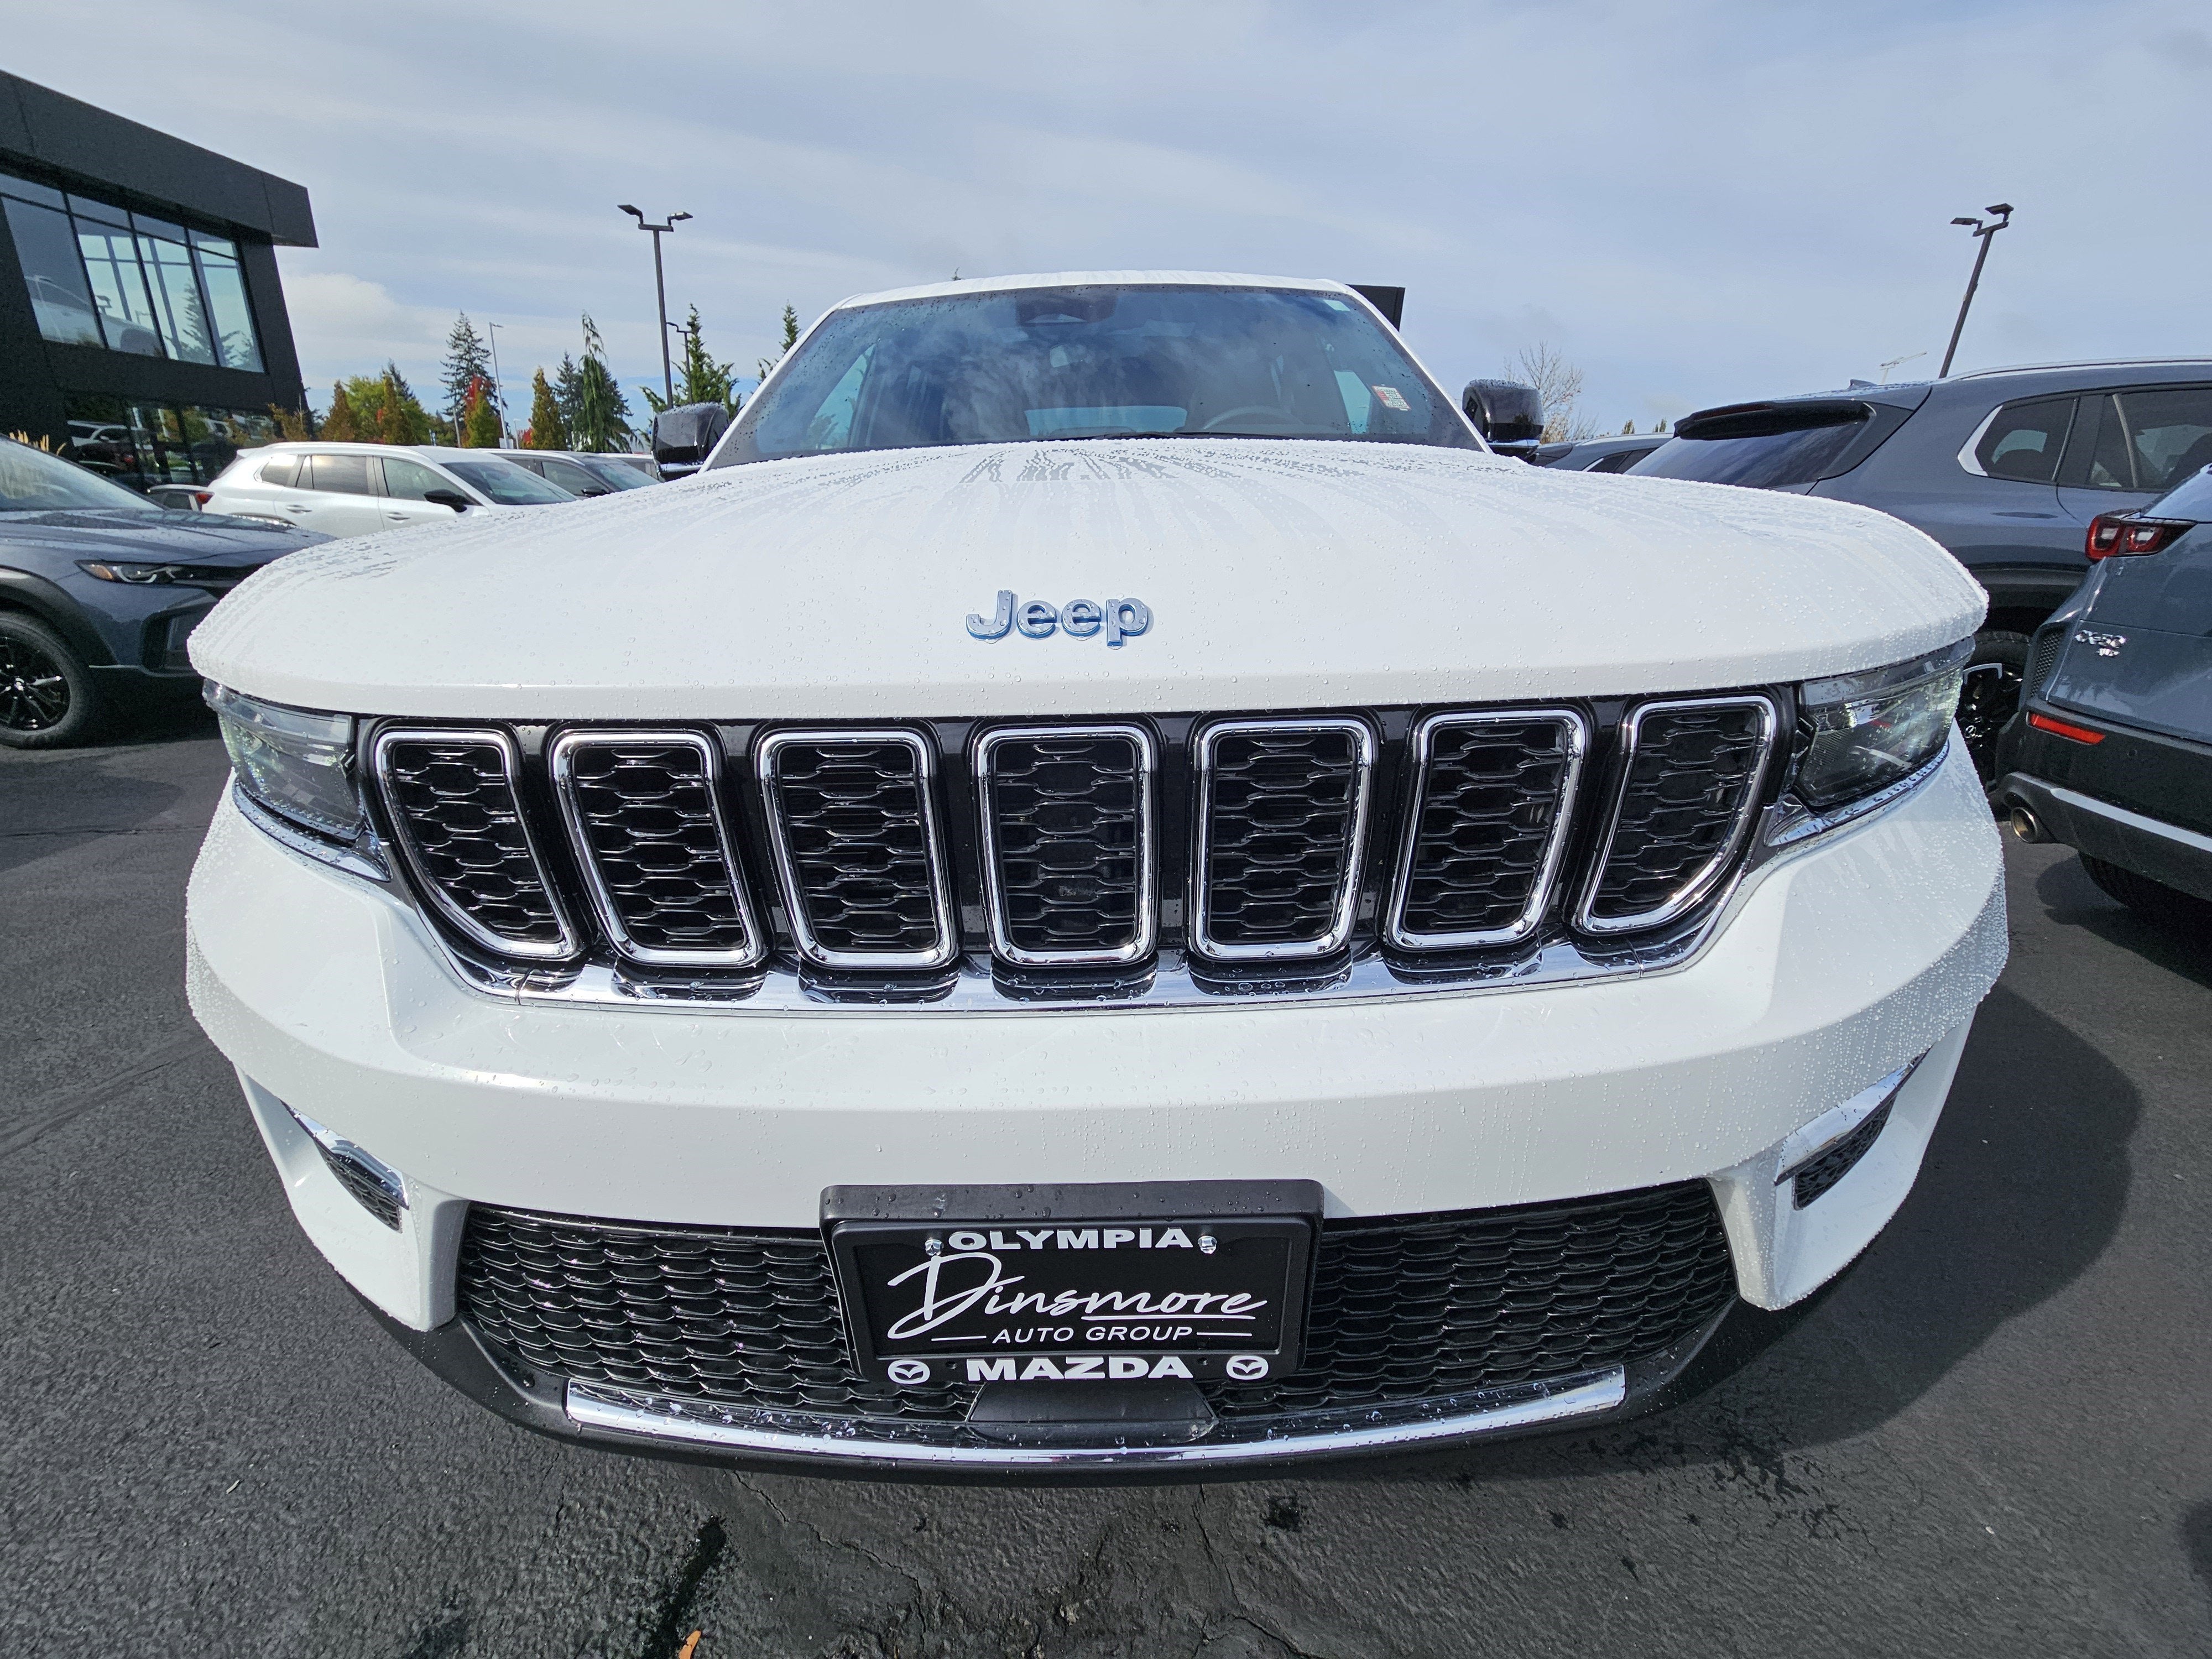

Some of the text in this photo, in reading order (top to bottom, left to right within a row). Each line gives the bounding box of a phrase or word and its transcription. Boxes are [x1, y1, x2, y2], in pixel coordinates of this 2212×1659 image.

[966, 589, 1149, 646] Jeep
[948, 1227, 1193, 1250] OLYMPIA
[887, 1252, 1267, 1339] Dinsmore
[992, 1326, 1193, 1344] AUTO GROUP
[967, 1356, 1194, 1381] MAZDA
